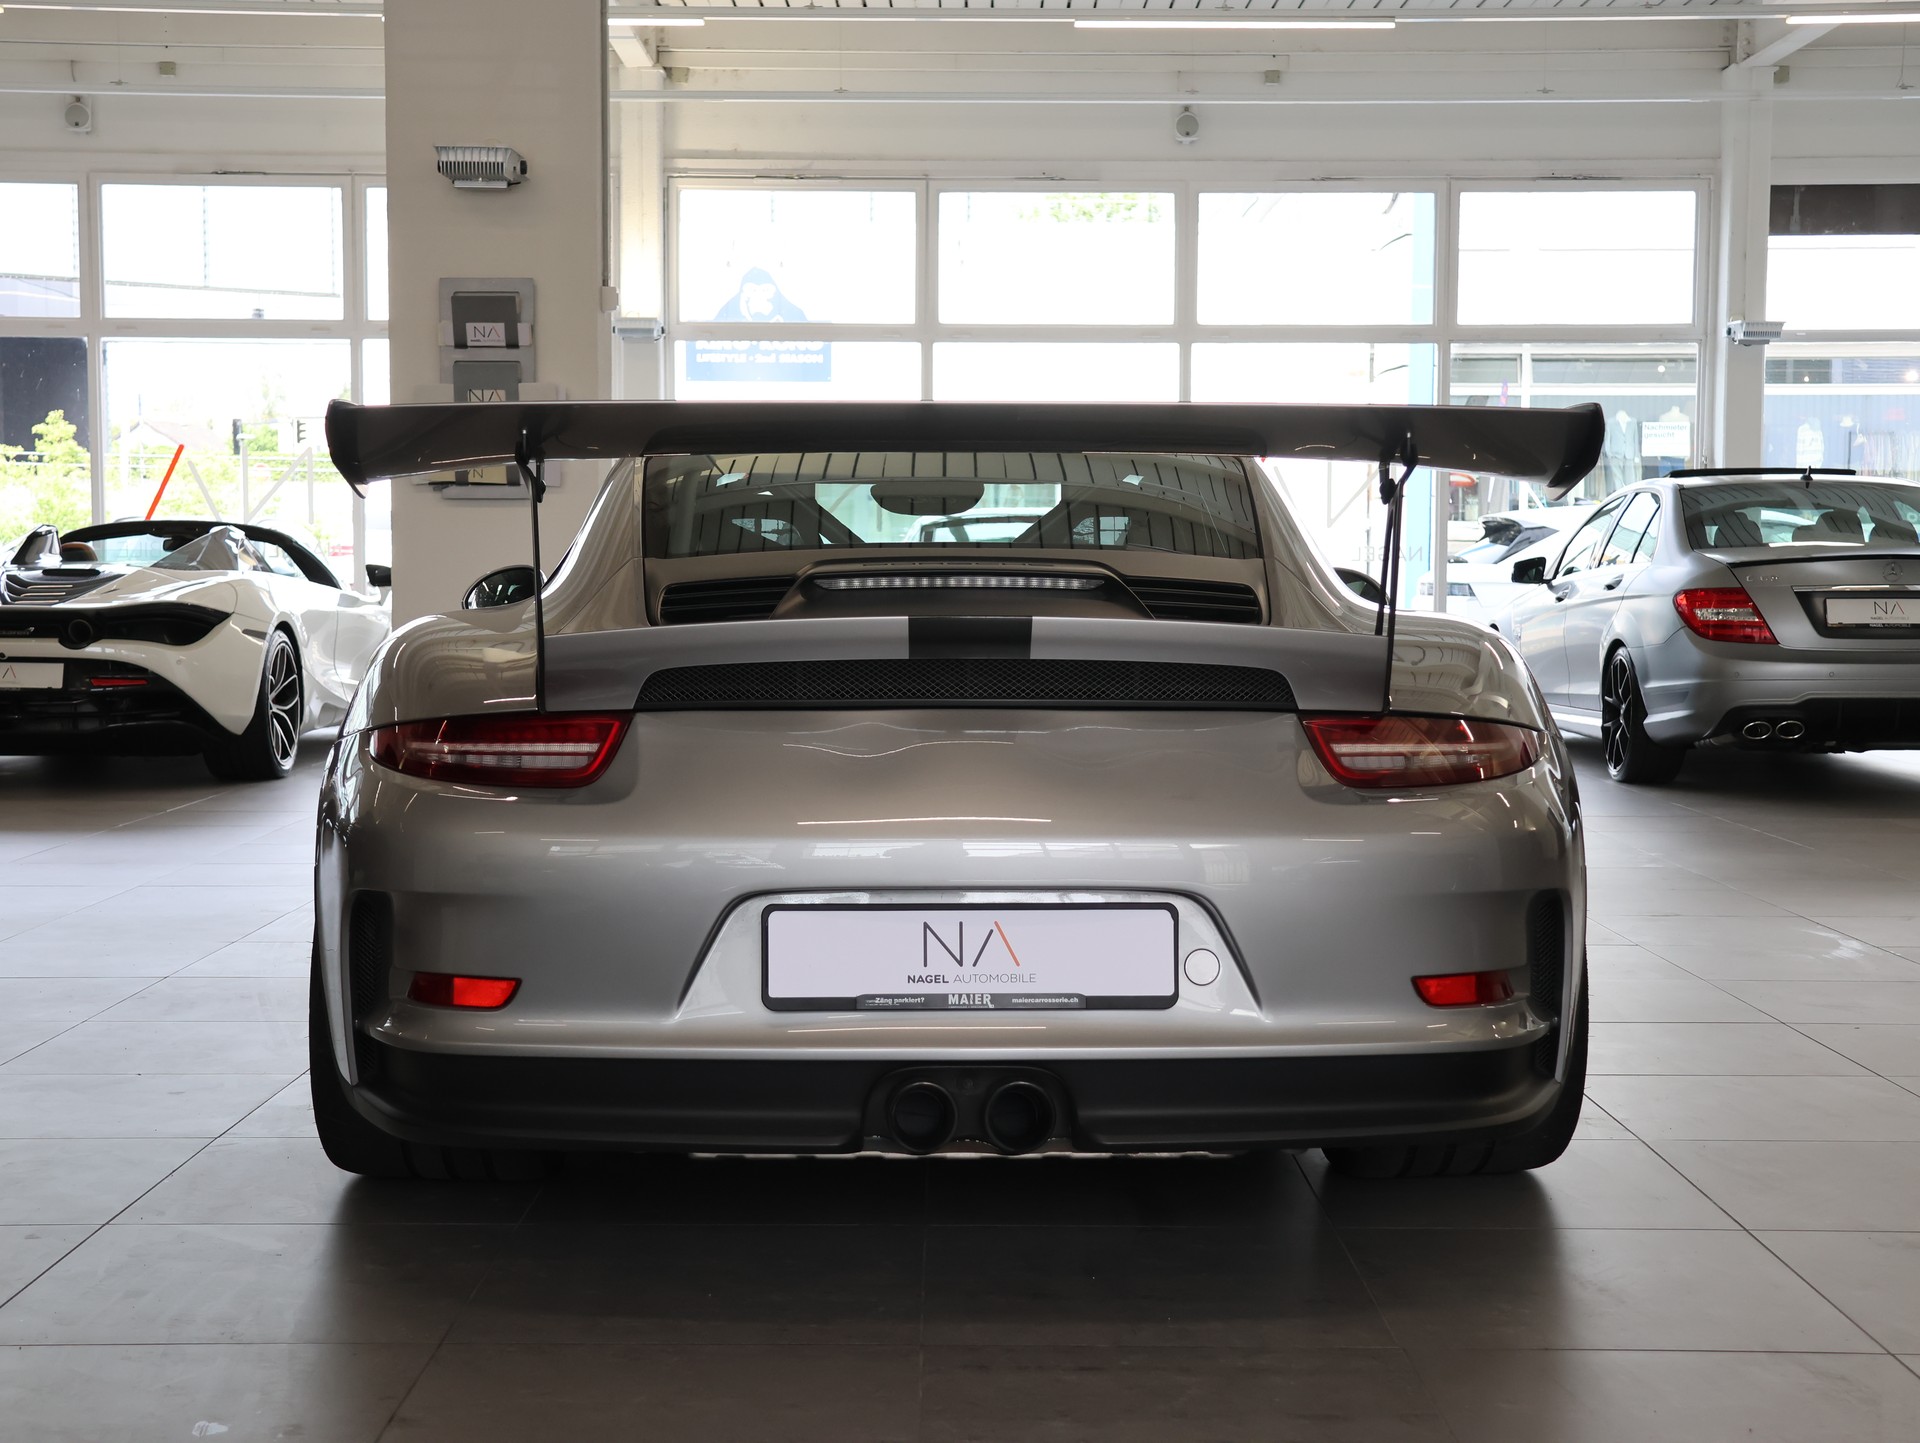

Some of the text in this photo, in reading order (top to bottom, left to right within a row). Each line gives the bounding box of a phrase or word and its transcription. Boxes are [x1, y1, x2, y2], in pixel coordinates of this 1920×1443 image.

[923, 921, 1021, 967] NA
[907, 973, 1037, 984] NAGEL AUTOMOBILE
[948, 993, 994, 1008] MAIER
